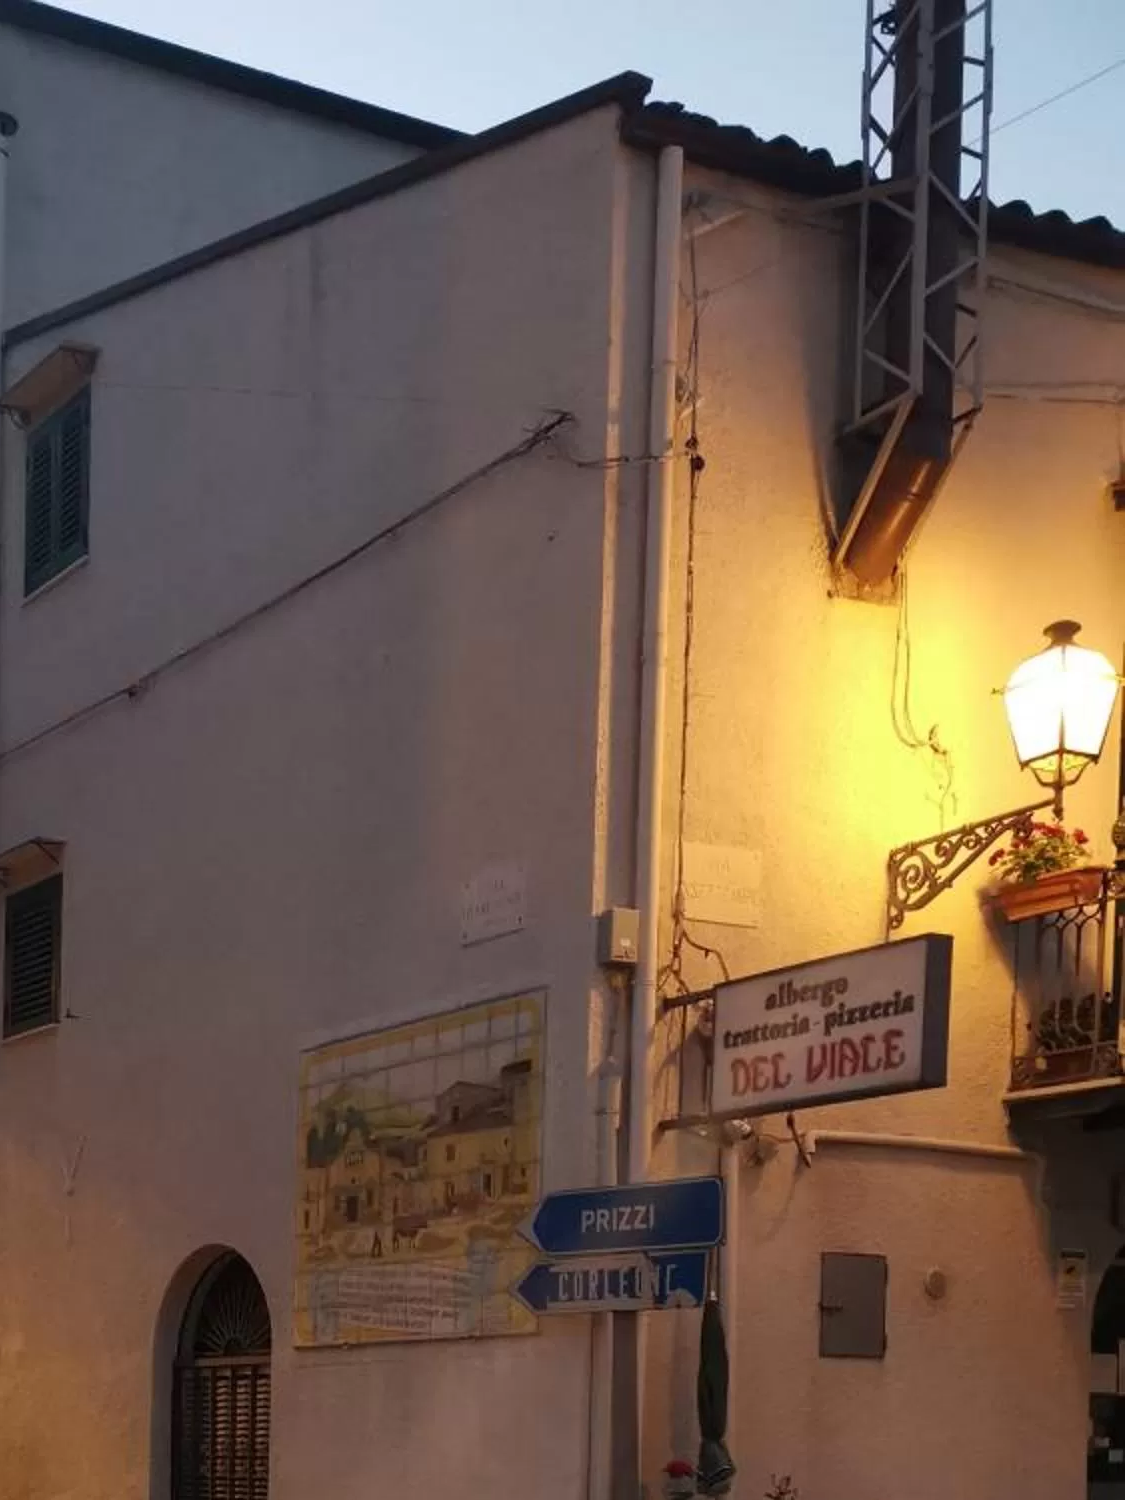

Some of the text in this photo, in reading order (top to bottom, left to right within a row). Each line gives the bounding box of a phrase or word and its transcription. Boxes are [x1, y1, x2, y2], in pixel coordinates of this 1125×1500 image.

[764, 977, 848, 1011] albergo
[723, 1013, 811, 1049] trattoria
[823, 991, 915, 1036] pizzeria
[730, 1028, 906, 1097] DEL VIALE
[581, 1204, 655, 1233] PRIZZI
